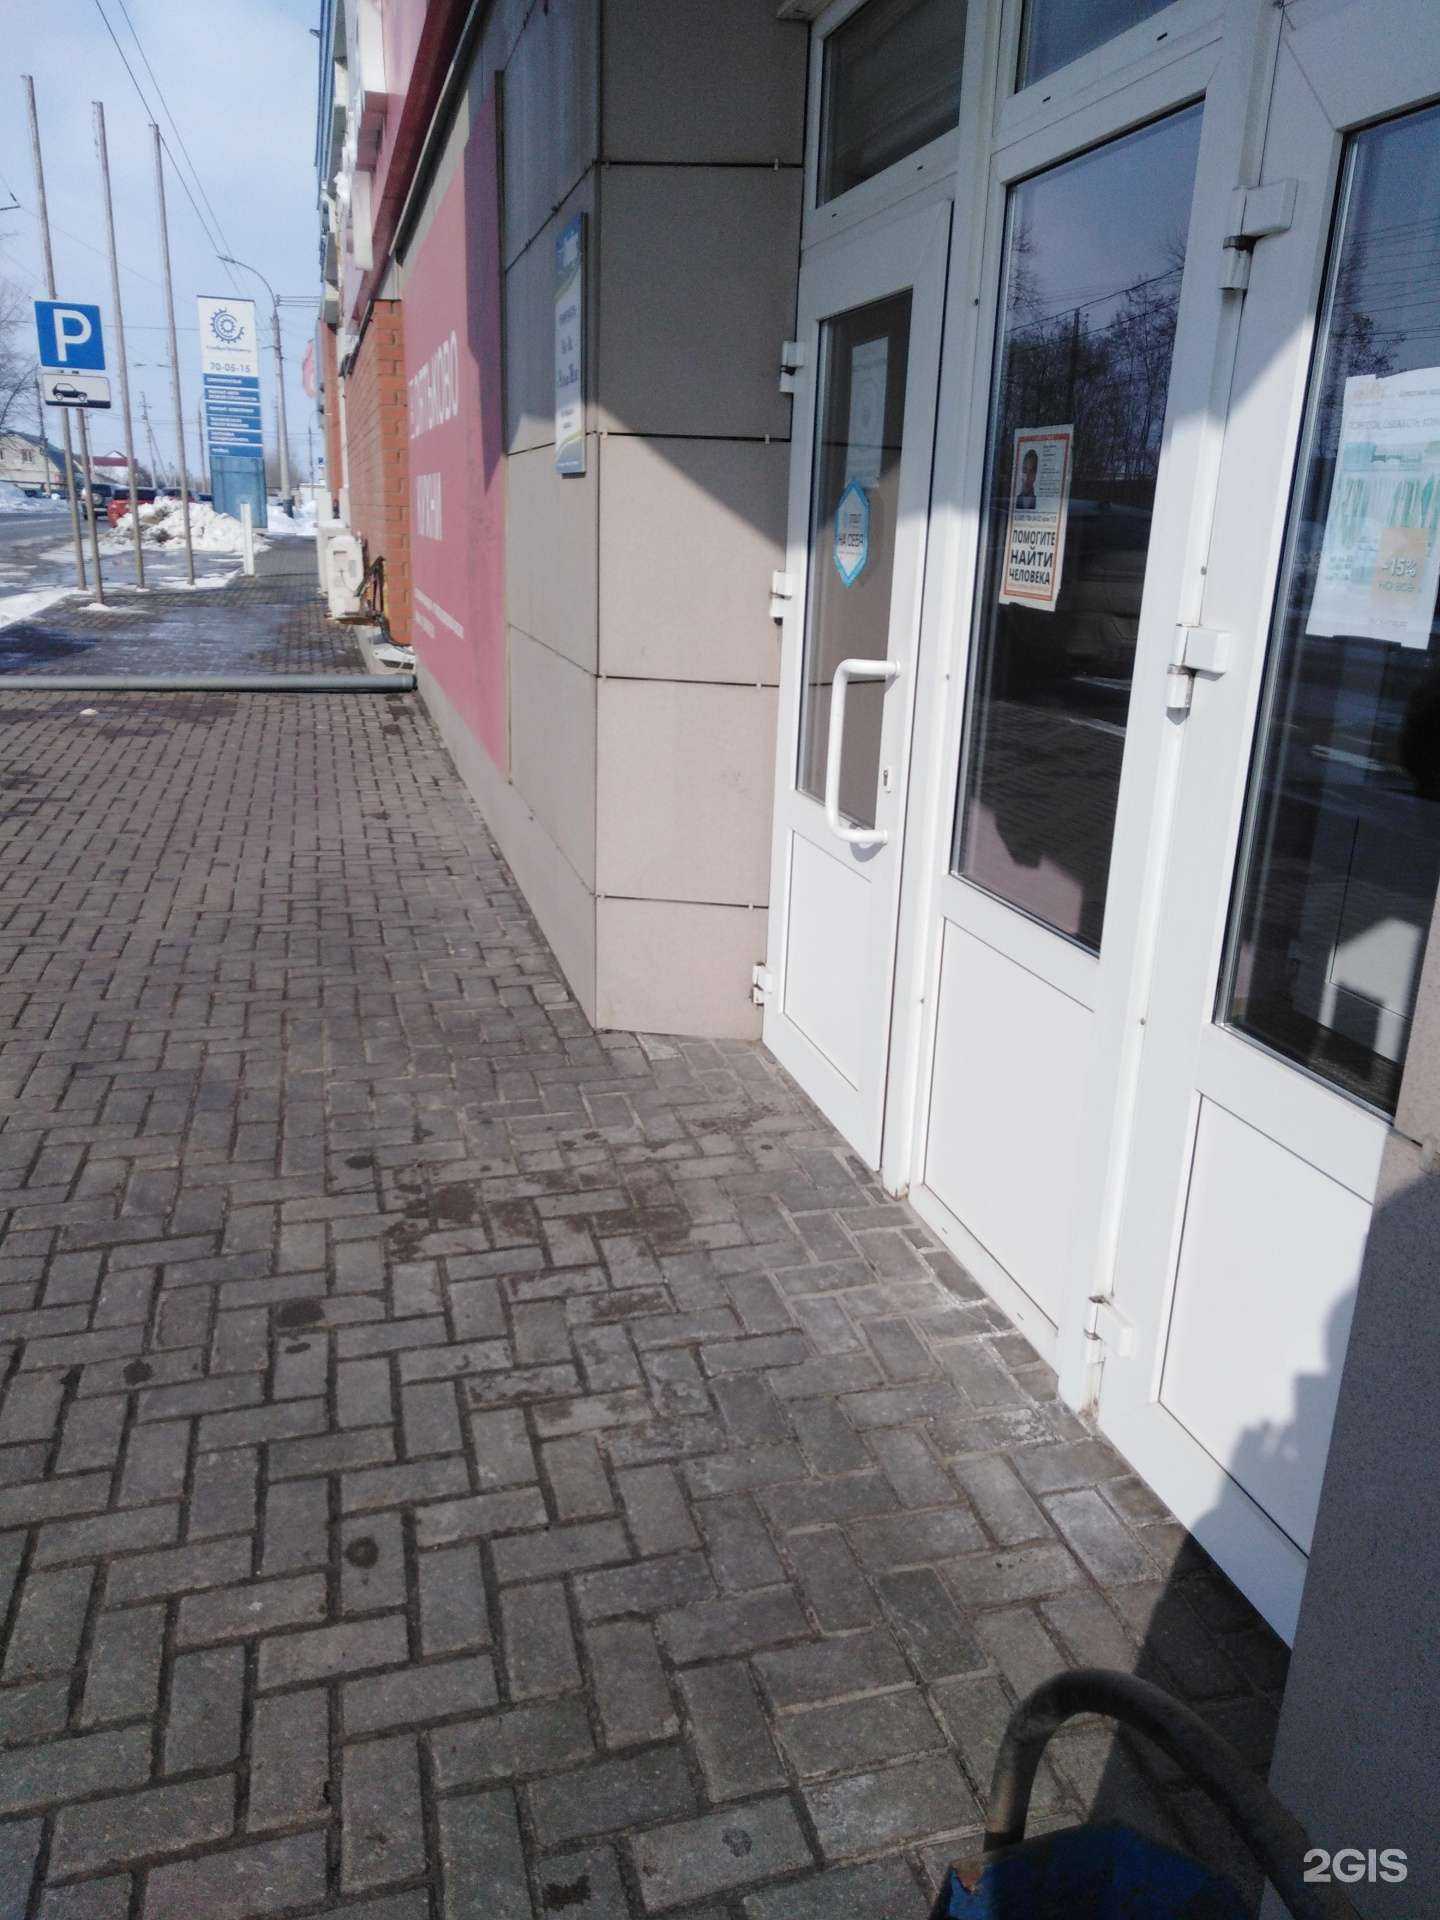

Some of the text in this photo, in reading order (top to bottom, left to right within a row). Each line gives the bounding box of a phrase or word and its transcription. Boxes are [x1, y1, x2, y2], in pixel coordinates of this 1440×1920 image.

[53, 308, 92, 362] P
[209, 361, 251, 373] 70-05-15
[1012, 530, 1056, 546] ПОМОГИТЕ
[1011, 546, 1054, 568] НАЙТИ
[1009, 568, 1050, 585] ЧЕЛОВЕКА
[1382, 558, 1417, 577] -15%
